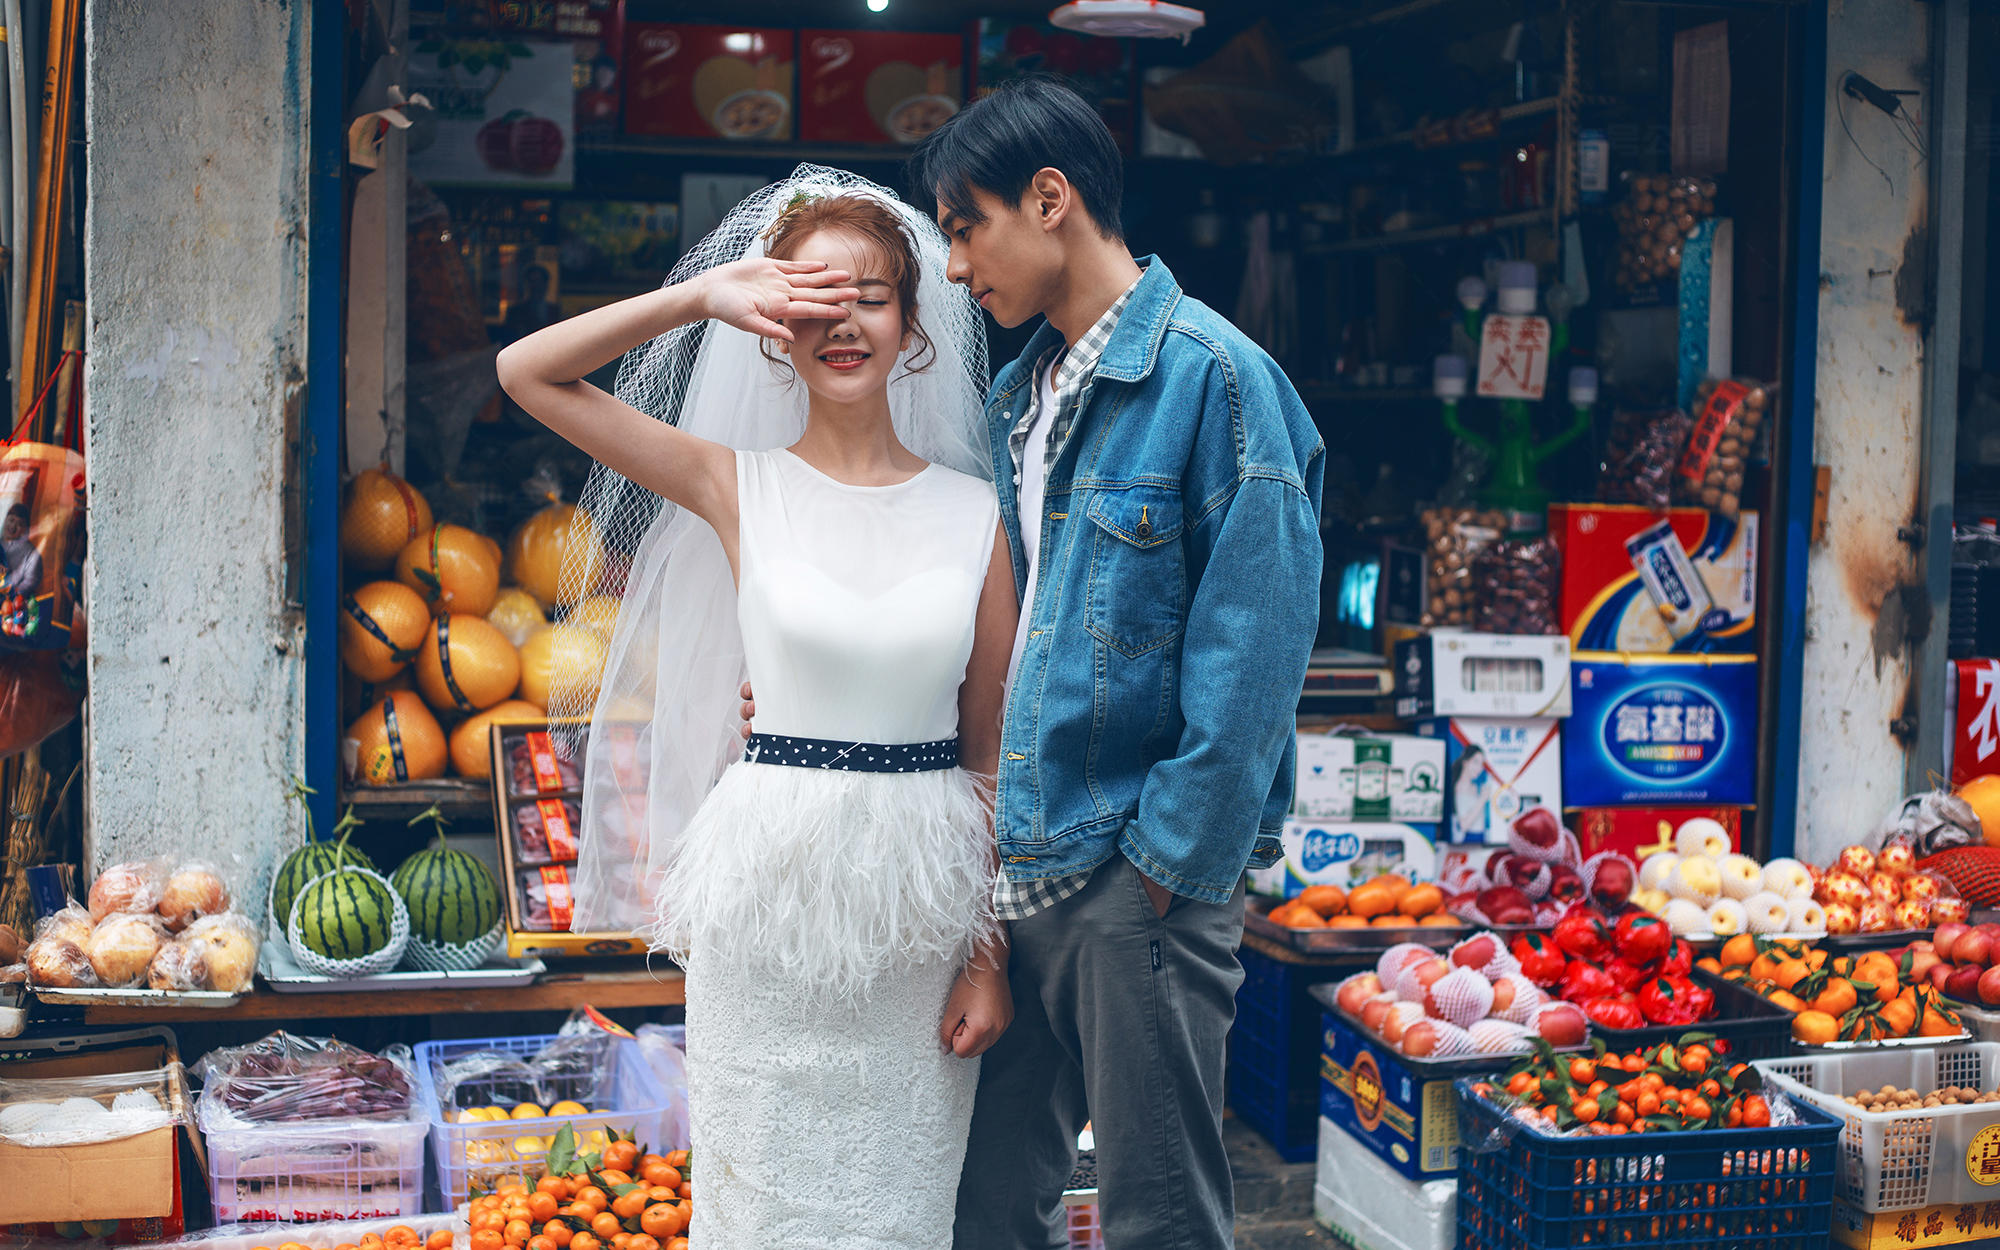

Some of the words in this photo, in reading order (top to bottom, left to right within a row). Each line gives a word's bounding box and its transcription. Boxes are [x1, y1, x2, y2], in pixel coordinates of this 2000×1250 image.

[1484, 726, 1528, 744] 安慕希
[1616, 704, 1715, 742] 氨基酸
[1305, 834, 1355, 859] 纯牛奶
